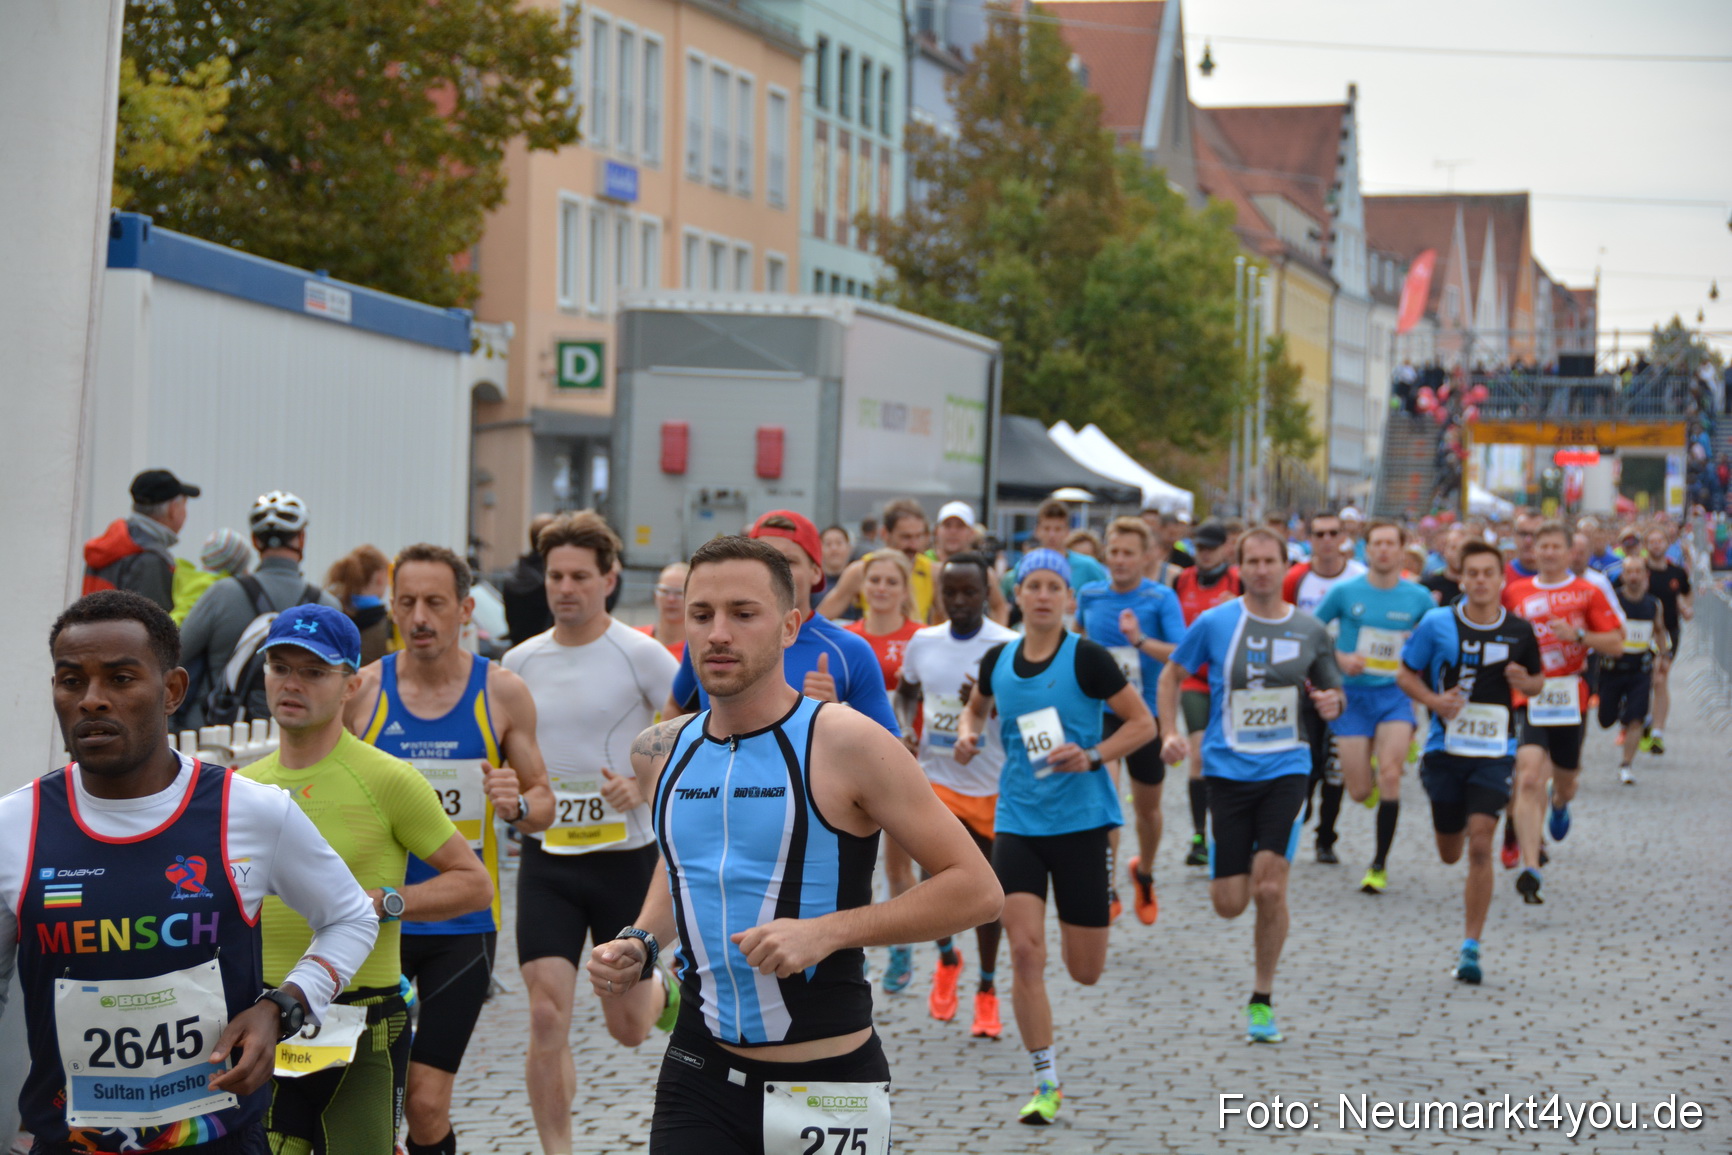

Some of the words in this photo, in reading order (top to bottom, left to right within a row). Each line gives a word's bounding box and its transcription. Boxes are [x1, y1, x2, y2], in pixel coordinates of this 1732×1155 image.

[562, 346, 599, 385] D
[1243, 706, 1287, 726] 2284
[1457, 720, 1498, 737] 2135
[559, 797, 604, 823] 278
[37, 911, 220, 954] MENSCH
[117, 987, 177, 1008] BOCK
[84, 1015, 203, 1070] 2645
[281, 1049, 312, 1064] Hynek
[94, 1083, 144, 1101] Sultan
[150, 1074, 206, 1101] Hersho
[822, 1096, 868, 1108] BOCK
[800, 1126, 868, 1155] 275
